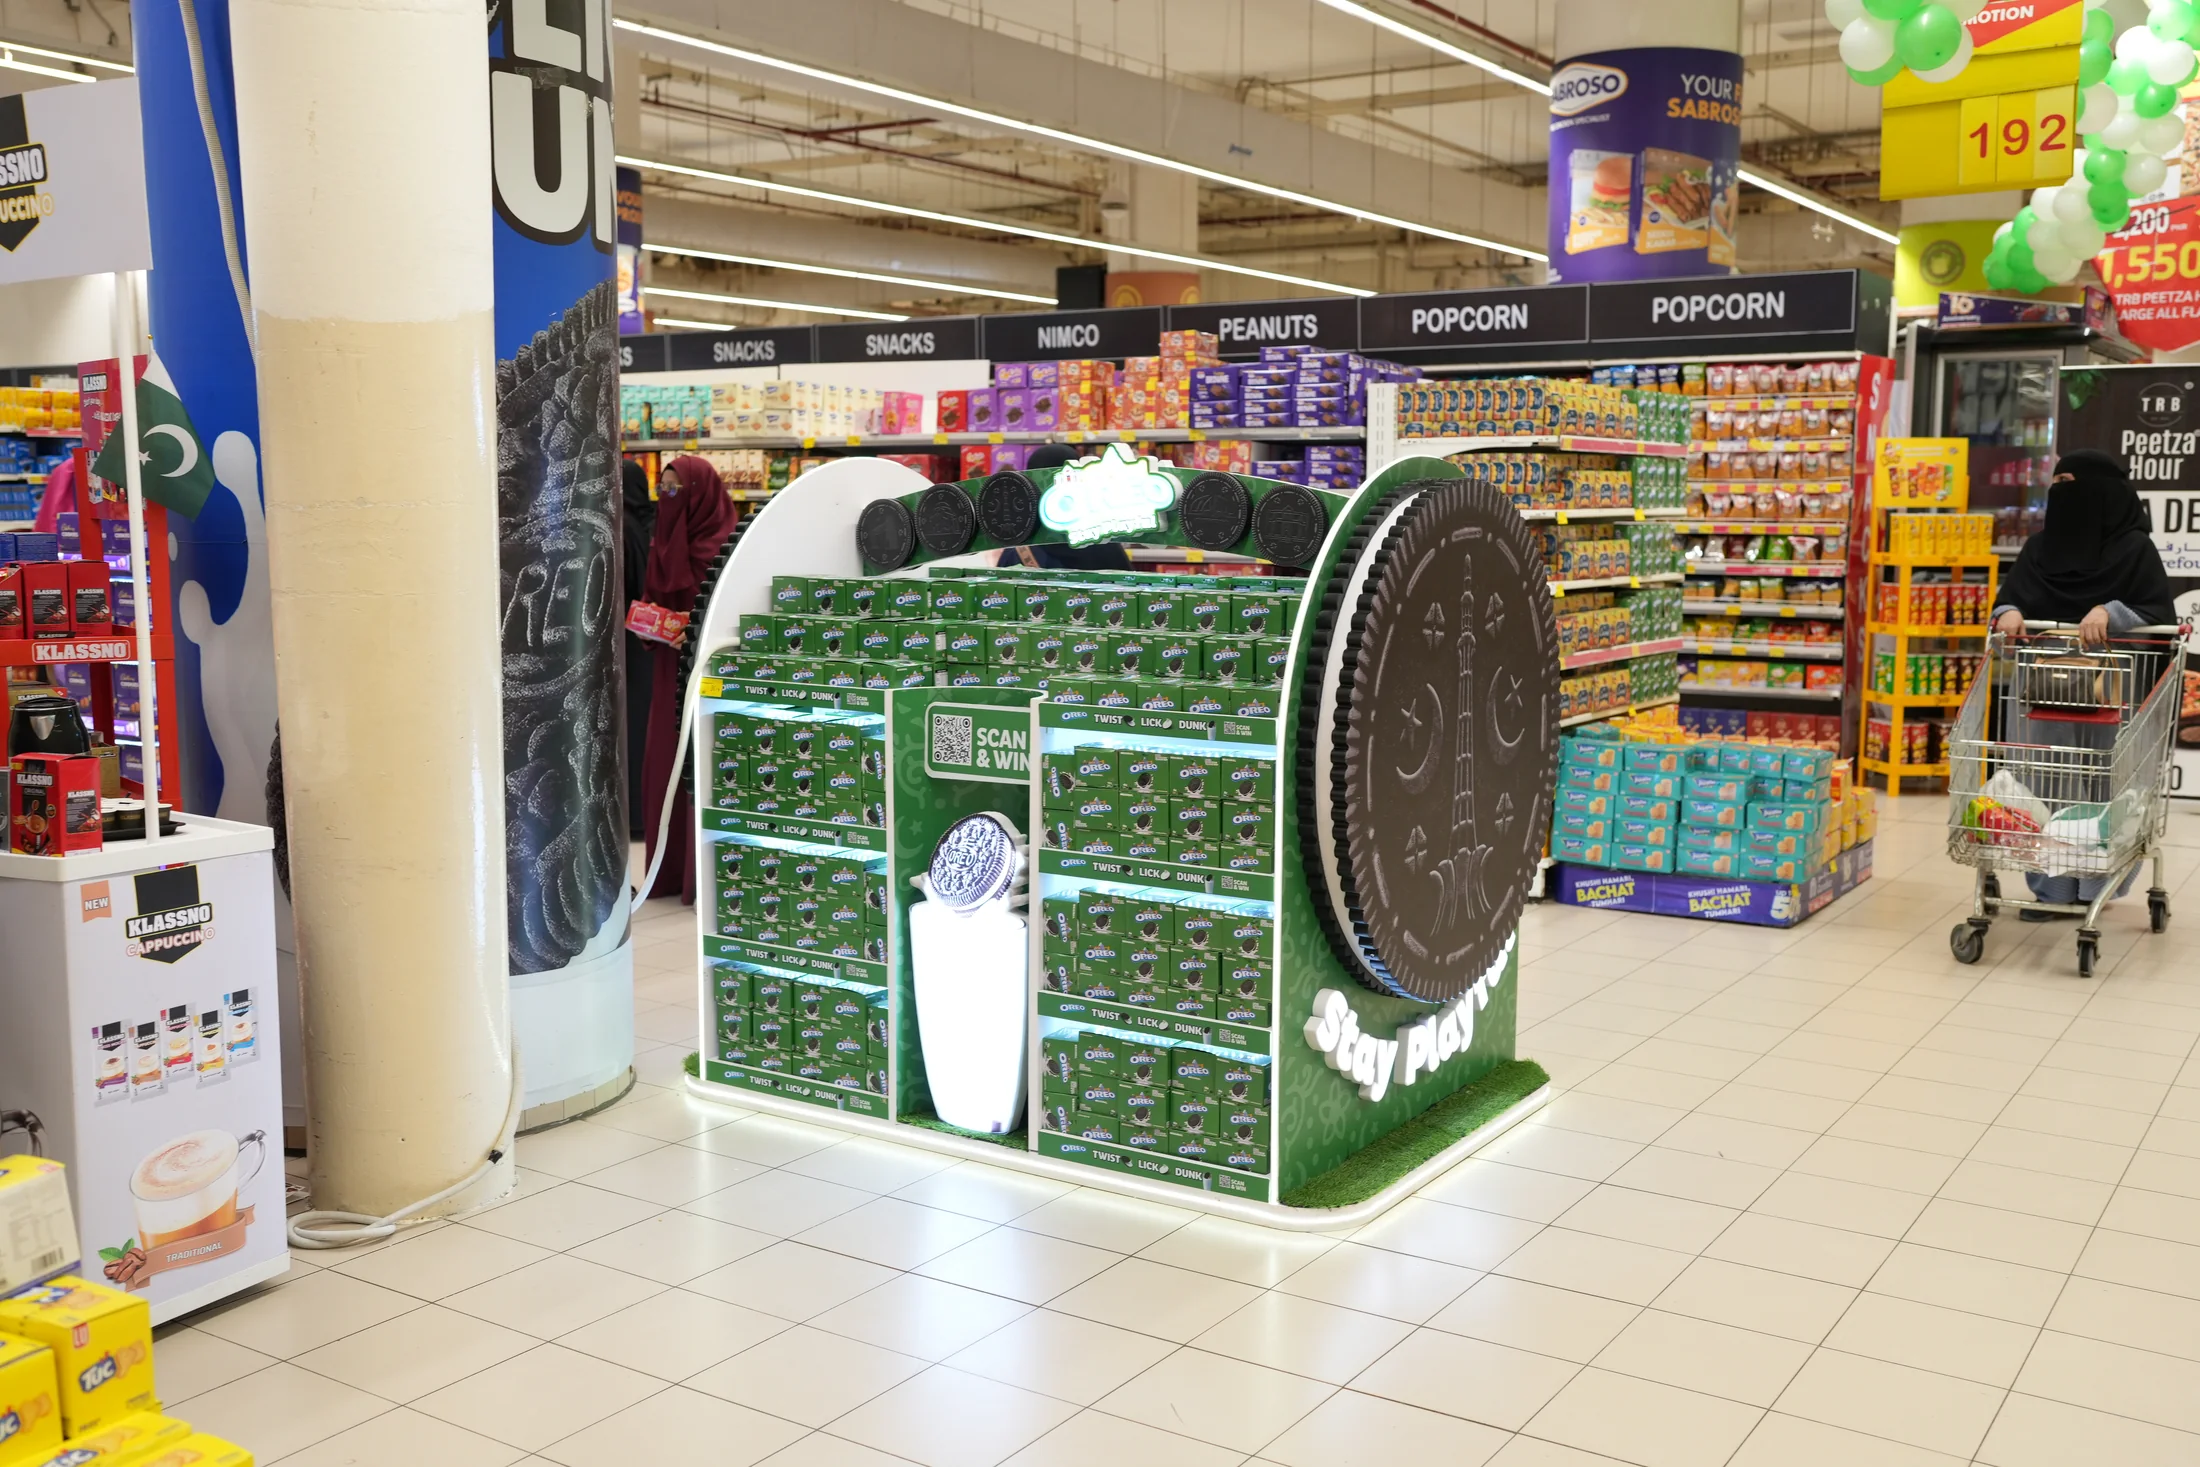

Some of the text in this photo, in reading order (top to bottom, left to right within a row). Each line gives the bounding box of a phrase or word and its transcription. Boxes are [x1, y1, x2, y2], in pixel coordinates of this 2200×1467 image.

[1681, 74, 1732, 100] YOUR
[1969, 114, 2067, 159] 192
[2115, 293, 2140, 306] TRB
[2143, 290, 2190, 304] PEETZA
[1652, 291, 1786, 323] POPCORN
[2156, 307, 2179, 320] ALL
[1411, 303, 1528, 334] POPCORN
[1037, 323, 1100, 349] NIMCO
[1218, 314, 1319, 342] PEANUTS
[713, 340, 776, 363] SNACKS
[865, 332, 936, 356] SNACKS
[2121, 430, 2196, 455] Peetza
[2129, 455, 2185, 480] Hour
[1066, 597, 1091, 606] OREO
[1102, 601, 1127, 612] OREO
[1193, 604, 1220, 614] OREO
[1242, 608, 1269, 616] OREO
[36, 642, 127, 661] KLASSNO
[1117, 646, 1143, 654] OREO
[1162, 648, 1188, 658] OREO
[1213, 651, 1240, 660] OREO
[745, 686, 768, 695] TWIST
[782, 689, 799, 698] LICK
[812, 692, 833, 701] DUNK
[1052, 694, 1084, 704] OREO
[1098, 696, 1129, 708] OREO
[1142, 701, 1174, 712] OREO
[1190, 703, 1221, 714] OREO
[1238, 706, 1270, 718] OREO
[1094, 714, 1123, 724] TWIST
[1141, 718, 1162, 727] LICK
[1179, 721, 1206, 731] DUNK
[976, 727, 1026, 750] SCAN
[976, 748, 991, 768] &
[1080, 763, 1110, 774] OREO
[1130, 763, 1158, 772] OREO
[1232, 771, 1260, 780] OREO
[17, 773, 53, 786] KLASSNO
[1080, 803, 1112, 815] OREO
[746, 821, 768, 830] TWIST
[783, 825, 799, 834] LICK
[813, 829, 834, 838] DUNK
[1082, 844, 1113, 856] OREO
[948, 850, 974, 868] OREO
[1093, 862, 1121, 873] TWIST
[1139, 868, 1160, 878] LICK
[1177, 872, 1205, 883] DUNK
[1575, 879, 1601, 888] KHUSHI
[1576, 882, 1635, 902] BACHAT
[1688, 889, 1716, 898] KHUSHI
[85, 897, 109, 911] NEW
[1591, 897, 1626, 908] TUMHARI
[1689, 893, 1751, 913] BACHAT
[127, 904, 212, 938] KLASSNO
[1704, 908, 1741, 918] TUMHARI
[126, 927, 216, 957] CAPPUCCINO
[746, 949, 768, 959] TWIST
[782, 955, 798, 964] LICK
[812, 960, 833, 970] DUNK
[1092, 1009, 1120, 1020] TWIST
[1138, 1016, 1159, 1027] LICK
[1175, 1023, 1203, 1035] DUNK
[1303, 988, 1399, 1102] Stay
[750, 1076, 772, 1087] TWIST
[786, 1084, 802, 1094] LICK
[815, 1090, 837, 1101] DUNK
[1093, 1150, 1120, 1163] TWIST
[1138, 1160, 1159, 1172] LICK
[1175, 1167, 1203, 1180] DUNK
[166, 1241, 223, 1263] TRADITIONAL
